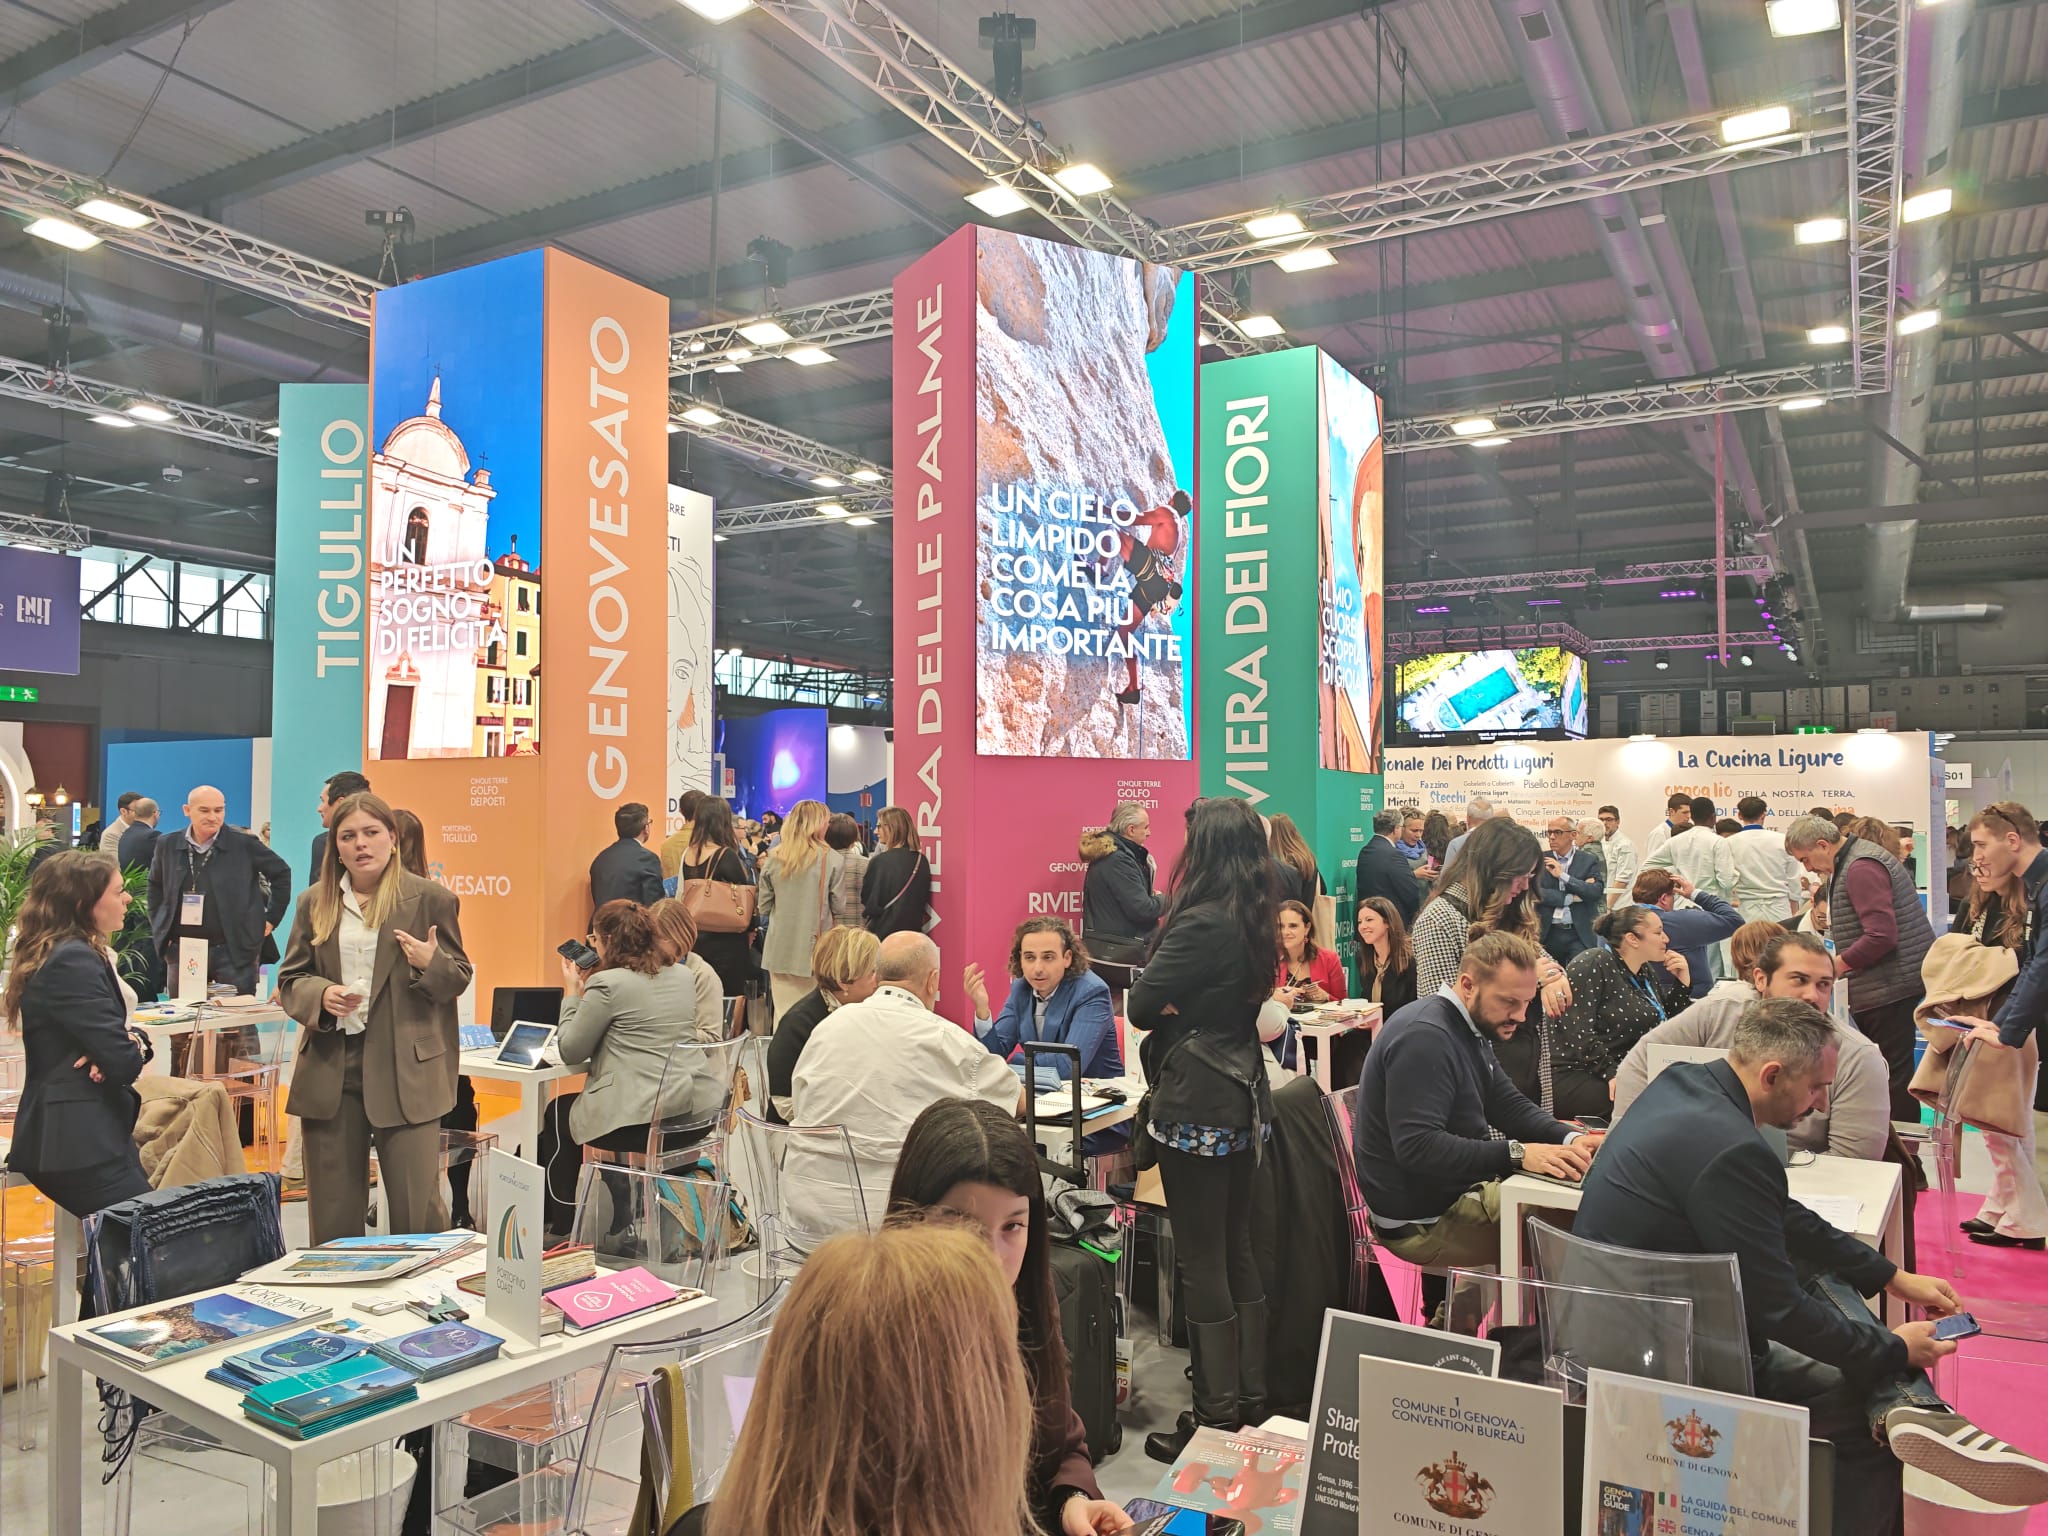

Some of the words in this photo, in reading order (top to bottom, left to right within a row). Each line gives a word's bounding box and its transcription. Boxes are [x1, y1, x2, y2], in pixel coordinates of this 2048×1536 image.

[917, 283, 943, 521] PALME
[1225, 395, 1270, 538] FIORI
[668, 503, 686, 517] RRE
[991, 483, 1041, 517] UN
[1048, 490, 1137, 527] CIELO
[317, 419, 364, 678] TIGULLIO
[667, 535, 681, 552] TI
[991, 517, 1122, 558] LIMPIDO
[381, 538, 416, 568] UN
[588, 316, 630, 799] GENOVESATO
[381, 558, 495, 598] PERFETTO
[990, 552, 1089, 589] COME
[1095, 562, 1133, 593] LA
[1225, 549, 1268, 635] DEI
[1322, 578, 1332, 603] IL
[1332, 584, 1353, 611] MIO
[16, 594, 52, 626] ENIT
[380, 591, 472, 626] SOGNO
[990, 588, 1082, 622] COSA
[1087, 591, 1134, 626] PIÙ
[917, 532, 942, 735] DELLE
[1322, 605, 1357, 639] CUORE
[380, 628, 402, 656] DI
[991, 621, 1183, 662] IMPORTANTE
[1322, 634, 1361, 666] SCOPPIA
[1322, 661, 1334, 686] DI
[1334, 667, 1361, 691] GIOIA
[1431, 755, 1452, 771] Dei
[1456, 753, 1508, 771] Prodotti
[1514, 752, 1554, 775] Liguri
[1678, 750, 1698, 769] La
[1705, 750, 1772, 768] Cucina
[1778, 748, 1844, 774] Ligure
[470, 785, 498, 796] GOLFO
[1117, 780, 1142, 788] CINQUE
[1143, 780, 1161, 788] TERRE
[1117, 788, 1150, 798] GOLFO
[1420, 780, 1449, 789] Fazzino
[1429, 790, 1467, 804] Stecchi
[1523, 778, 1549, 789] Pisello
[1550, 779, 1558, 789] di
[1560, 778, 1595, 791] Lavagna
[1738, 790, 1768, 798] DELLA
[1772, 790, 1815, 798] NOSTRA
[470, 797, 482, 806] DEI
[483, 796, 505, 807] POETI
[1515, 807, 1541, 818] Cinque
[1542, 807, 1560, 816] Terre
[1561, 807, 1586, 816] bianco
[1778, 809, 1808, 817] DELLA
[442, 833, 478, 843] TIGULLIO
[496, 1265, 526, 1291] PORTOFINO
[496, 1278, 513, 1295] COAST
[1392, 1397, 1447, 1417] COMUNE
[1449, 1408, 1462, 1419] DI
[1464, 1411, 1518, 1431] GENOVA
[1453, 1396, 1460, 1407] 1
[1391, 1409, 1475, 1434] CONVENTION
[1477, 1425, 1526, 1445] BUREAU
[1646, 1453, 1685, 1469] COMUNE
[1687, 1462, 1699, 1471] DI
[1700, 1465, 1739, 1480] GENOVA
[1314, 1493, 1339, 1508] UNESCO
[1603, 1486, 1633, 1499] GENOA
[1603, 1493, 1622, 1503] CITY
[1603, 1500, 1631, 1512] GUIDE
[1681, 1495, 1694, 1505] LA
[1695, 1498, 1728, 1513] GUIDA
[1729, 1505, 1749, 1518] DEL
[1751, 1511, 1799, 1529] COMUNE
[1681, 1504, 1691, 1514] DI
[1692, 1507, 1736, 1525] GENOVA
[1393, 1512, 1447, 1534] COMUNE
[1449, 1525, 1462, 1536] DI
